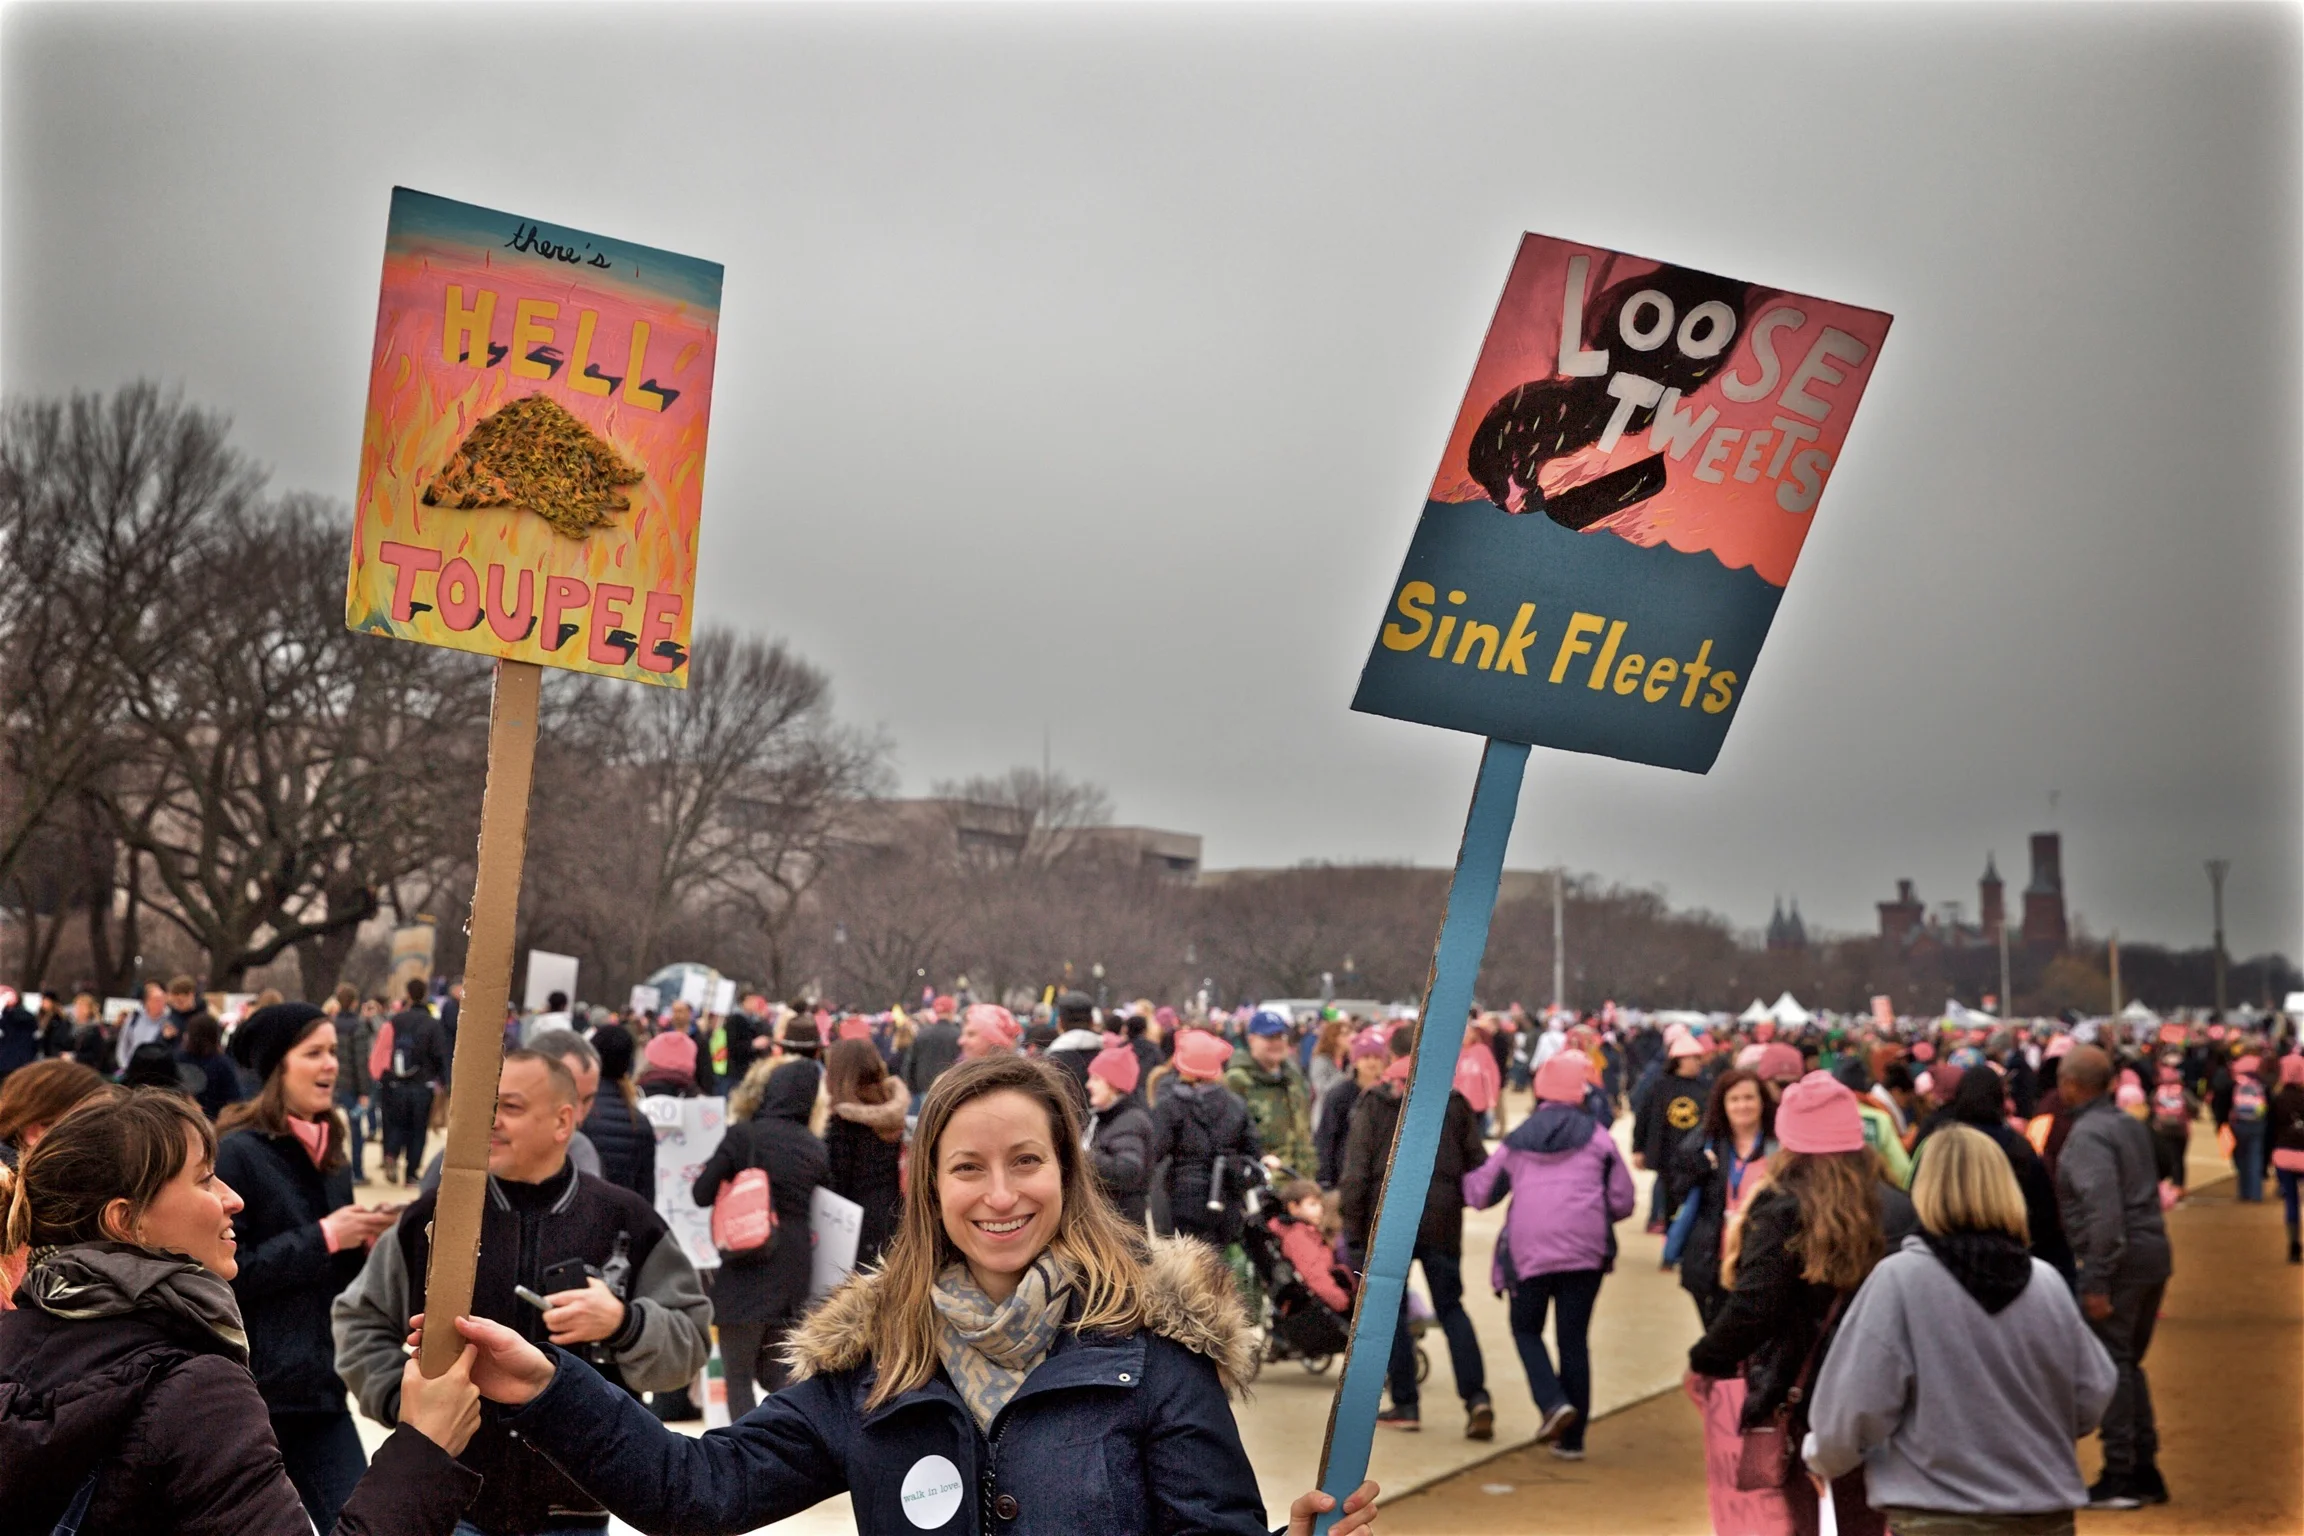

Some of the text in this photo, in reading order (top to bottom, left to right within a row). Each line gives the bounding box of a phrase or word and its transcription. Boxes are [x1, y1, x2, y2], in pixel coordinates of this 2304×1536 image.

[503, 222, 612, 269] there's
[442, 284, 672, 413] HELL
[1557, 253, 1870, 422] LOOSE
[1596, 371, 1832, 513] TWEETS
[379, 540, 685, 674] TOUPEE
[1382, 580, 1739, 715] Sink Fleets
[903, 1481, 961, 1502] walk in love.
